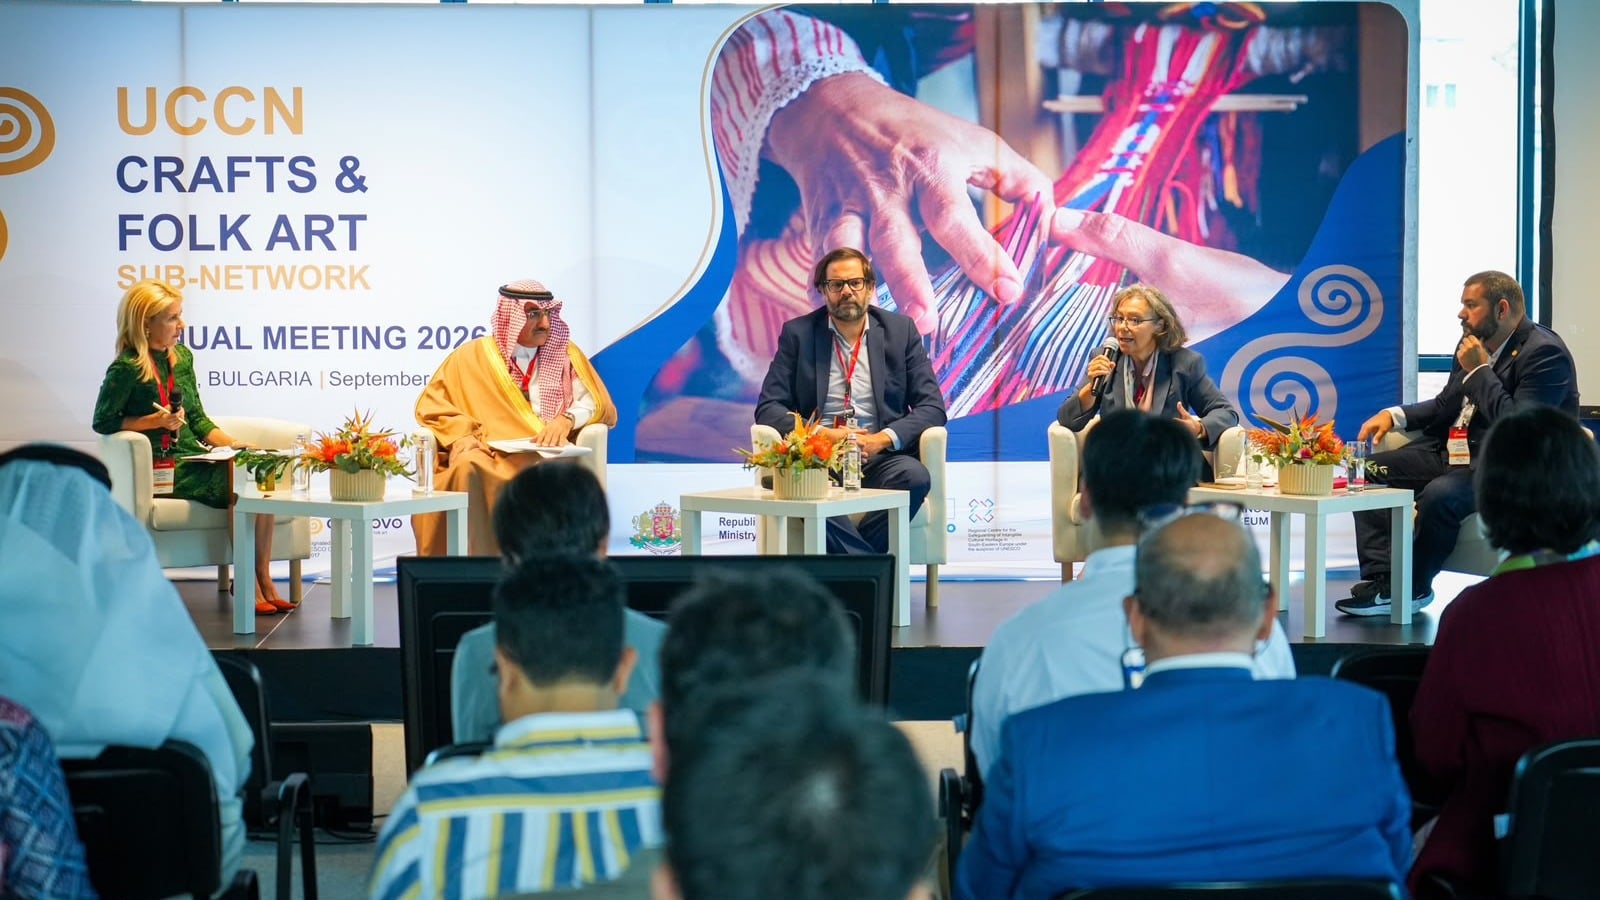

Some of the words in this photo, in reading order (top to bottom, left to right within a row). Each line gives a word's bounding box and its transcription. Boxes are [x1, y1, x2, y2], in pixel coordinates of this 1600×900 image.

[117, 86, 304, 136] UCCN
[116, 156, 317, 194] CRAFTS
[335, 155, 369, 194] &
[118, 214, 252, 252] FOLK
[265, 214, 368, 251] ART
[178, 326, 253, 350] UAL
[263, 325, 407, 350] MEETING
[208, 370, 313, 387] BULGARIA
[329, 370, 430, 390] September
[719, 517, 756, 528] Republi
[1244, 517, 1269, 526] EUM
[719, 530, 756, 542] Ministry
